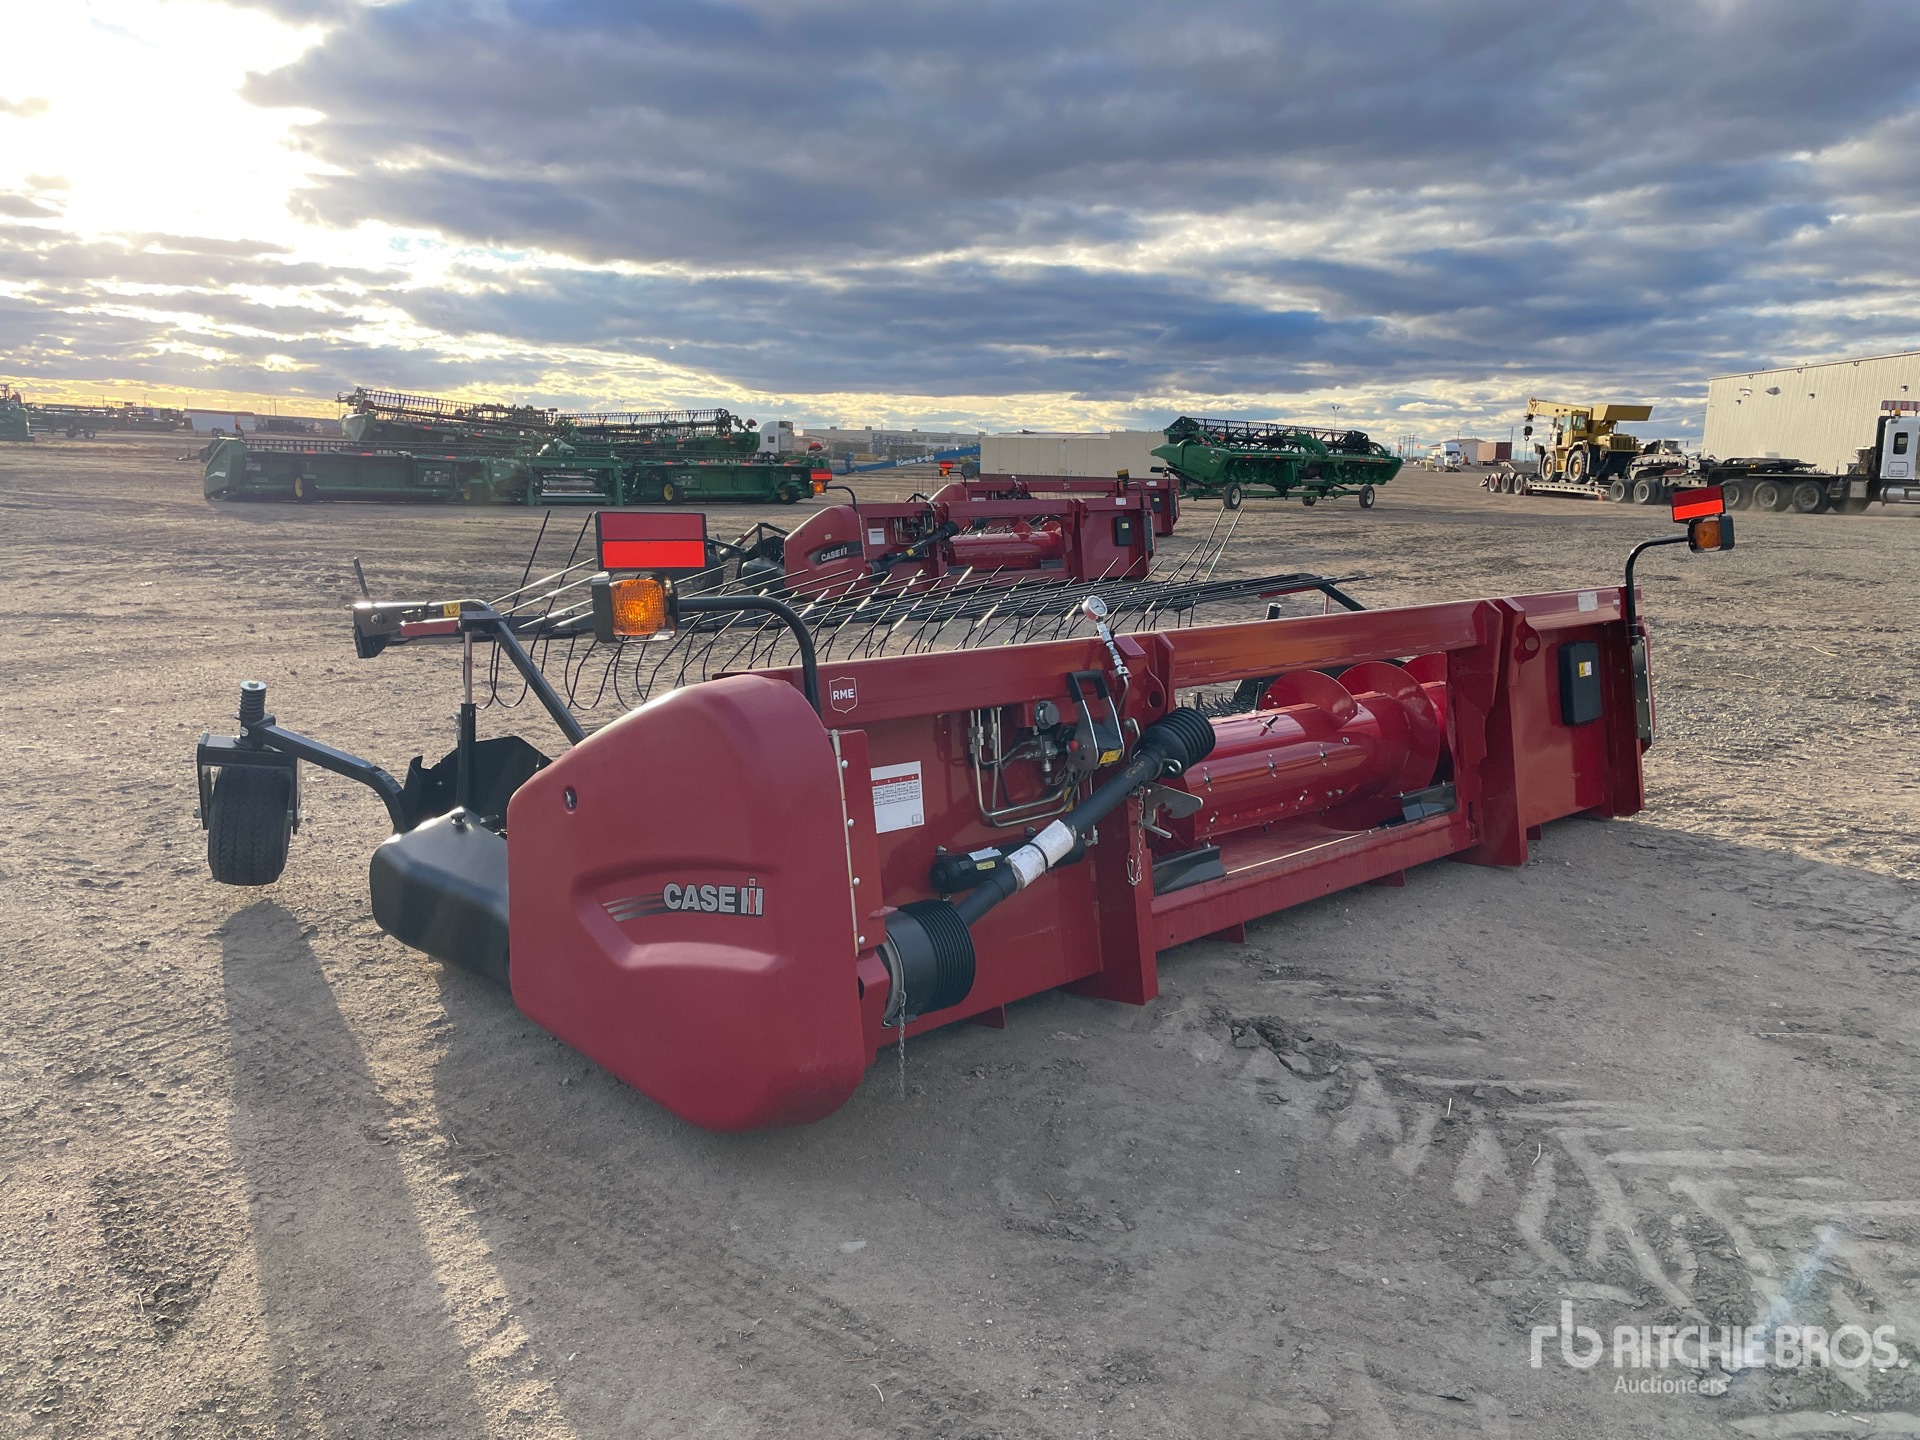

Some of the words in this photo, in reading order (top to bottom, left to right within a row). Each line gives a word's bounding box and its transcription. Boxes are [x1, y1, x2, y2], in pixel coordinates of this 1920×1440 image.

[917, 454, 935, 463] S-80
[821, 549, 841, 562] CASE
[832, 688, 855, 701] RME
[663, 883, 737, 913] CASE
